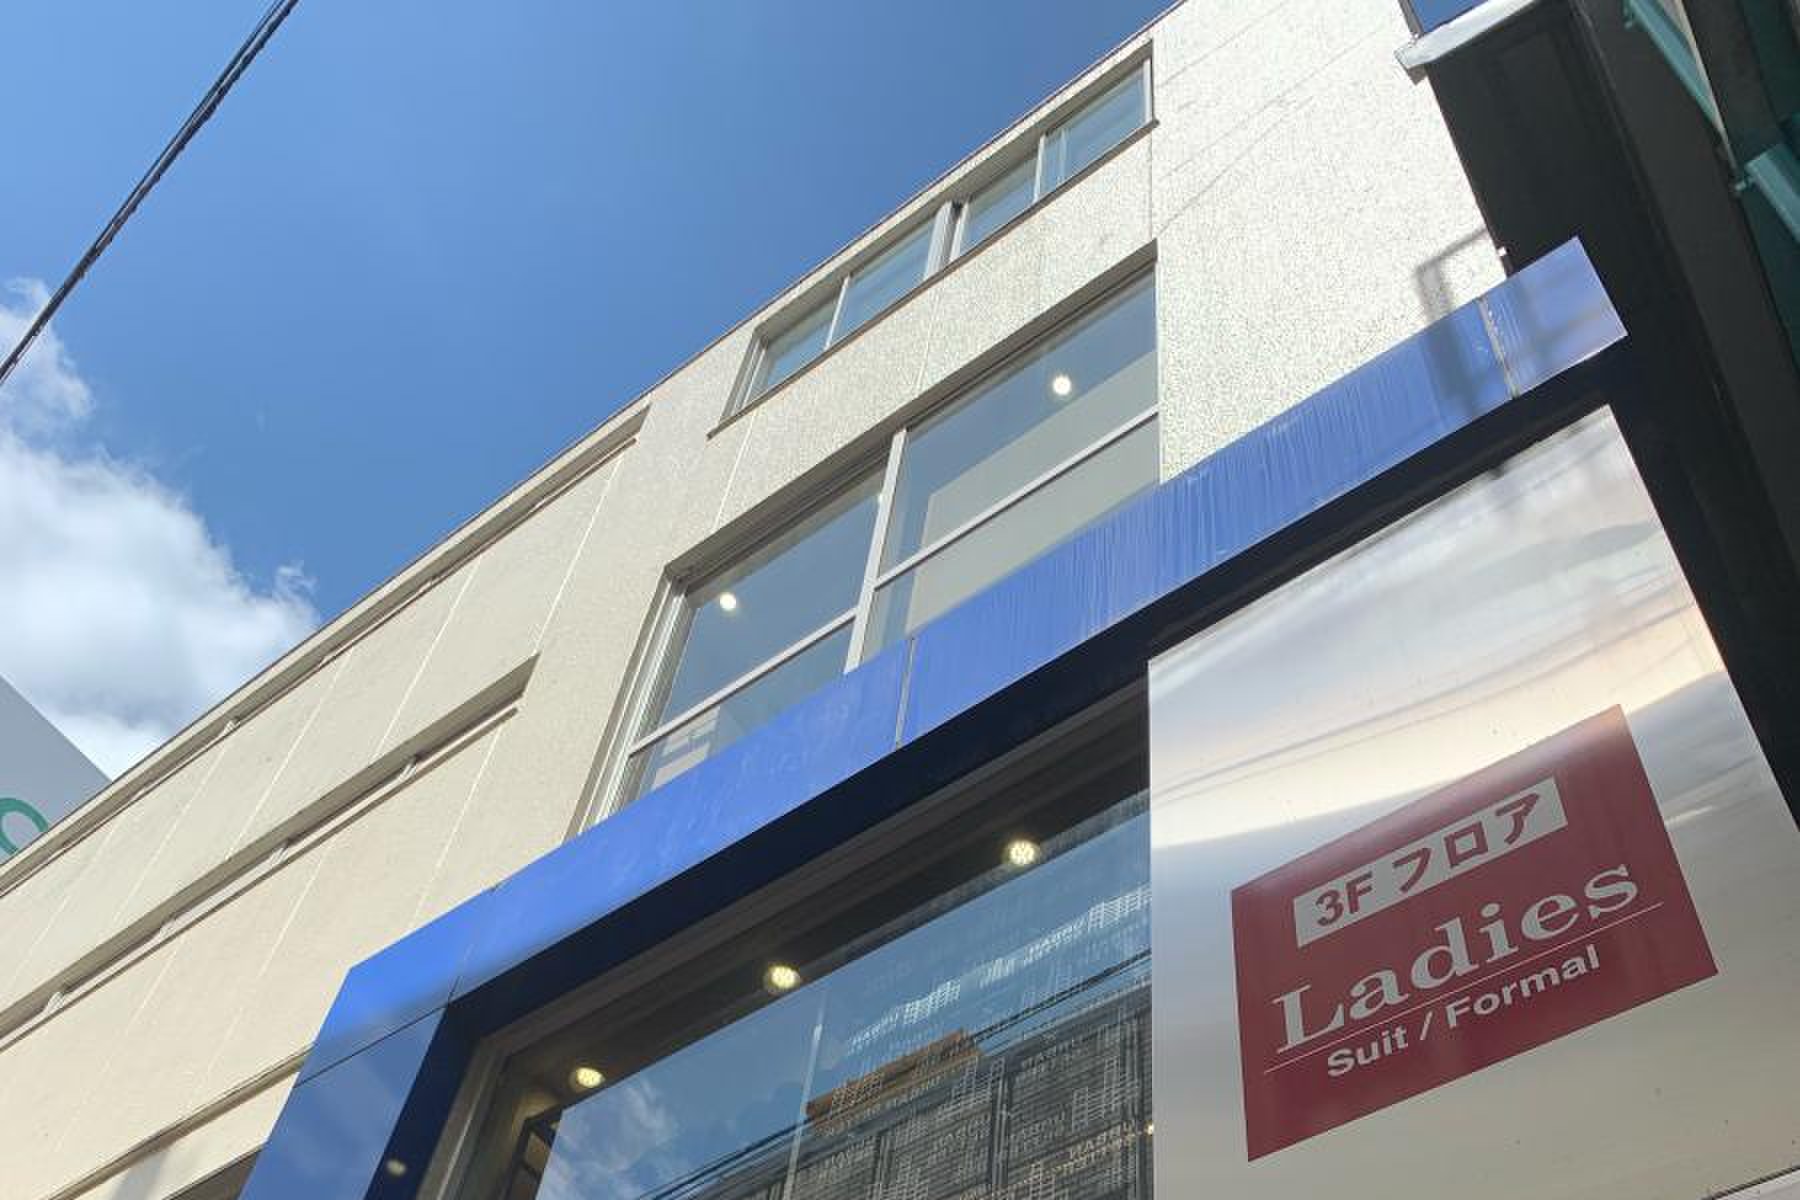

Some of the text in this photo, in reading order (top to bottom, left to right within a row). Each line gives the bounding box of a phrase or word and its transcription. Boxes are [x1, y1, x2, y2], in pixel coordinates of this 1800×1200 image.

[1316, 794, 1541, 927] 3F フロア
[1273, 863, 1639, 1055] Ladies
[1327, 1024, 1409, 1078] Suit
[1446, 943, 1601, 1030] Formal
